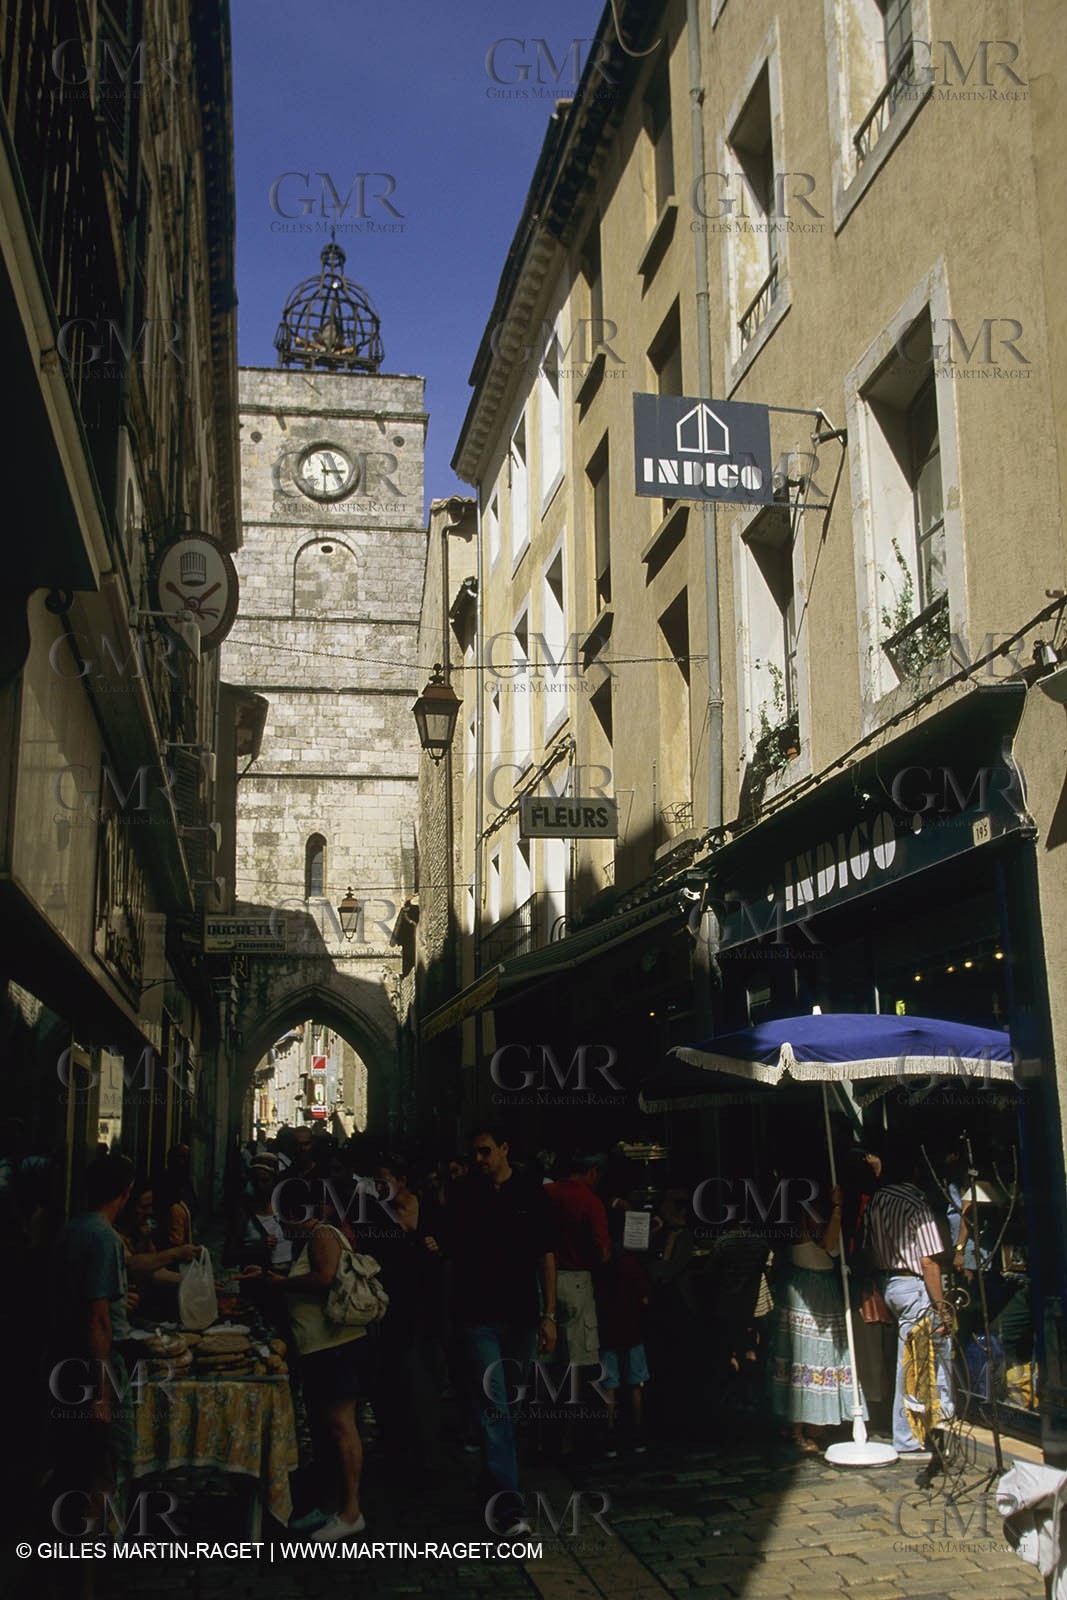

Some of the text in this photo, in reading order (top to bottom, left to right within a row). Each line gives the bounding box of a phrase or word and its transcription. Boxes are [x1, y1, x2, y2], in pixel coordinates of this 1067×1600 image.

[643, 457, 763, 490] INDIGO
[531, 806, 609, 828] FLEURS
[976, 824, 988, 841] 195
[784, 811, 897, 913] INDIGO
